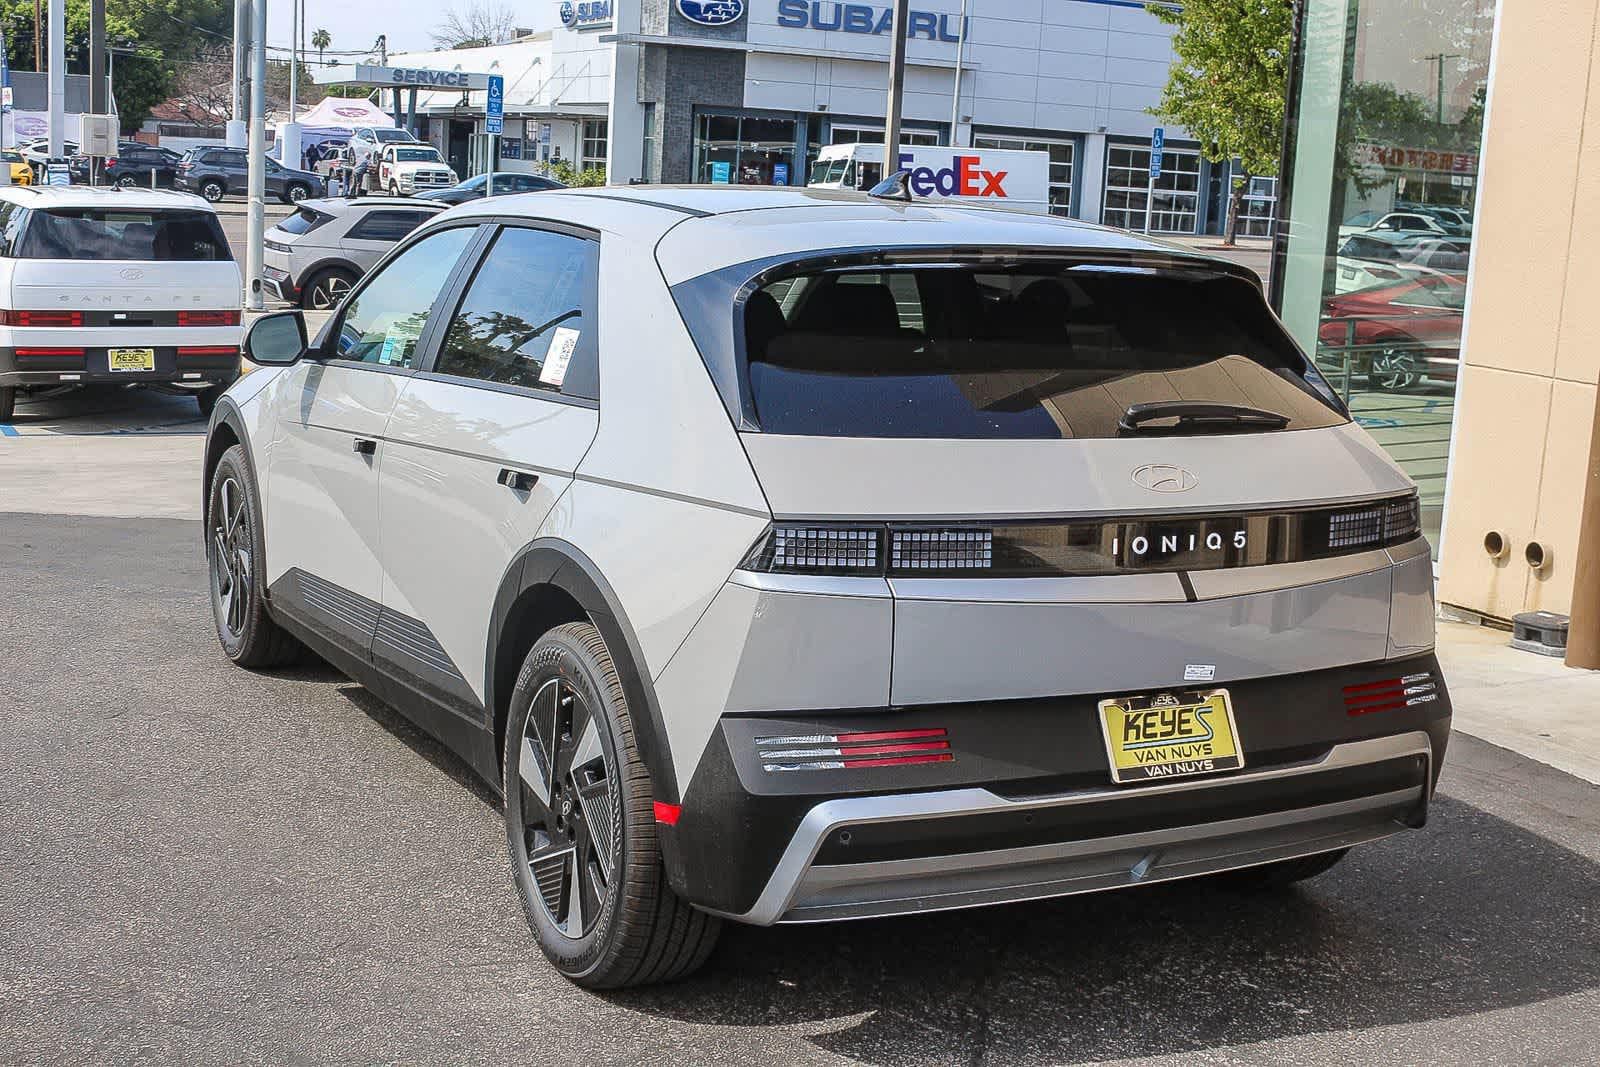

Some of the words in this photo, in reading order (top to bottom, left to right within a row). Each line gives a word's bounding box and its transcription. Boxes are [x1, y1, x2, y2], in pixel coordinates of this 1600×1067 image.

[577, 1, 613, 20] SUBA
[777, 0, 969, 42] SUBARU
[392, 69, 469, 86] SERVICE
[898, 154, 1008, 197] FedEx
[115, 353, 148, 362] KEYES
[1122, 705, 1214, 743] KEYES
[1134, 750, 1166, 763] VAN
[1171, 743, 1213, 760] NUYS
[1145, 764, 1173, 777] VAN
[1176, 759, 1214, 775] NUYS
